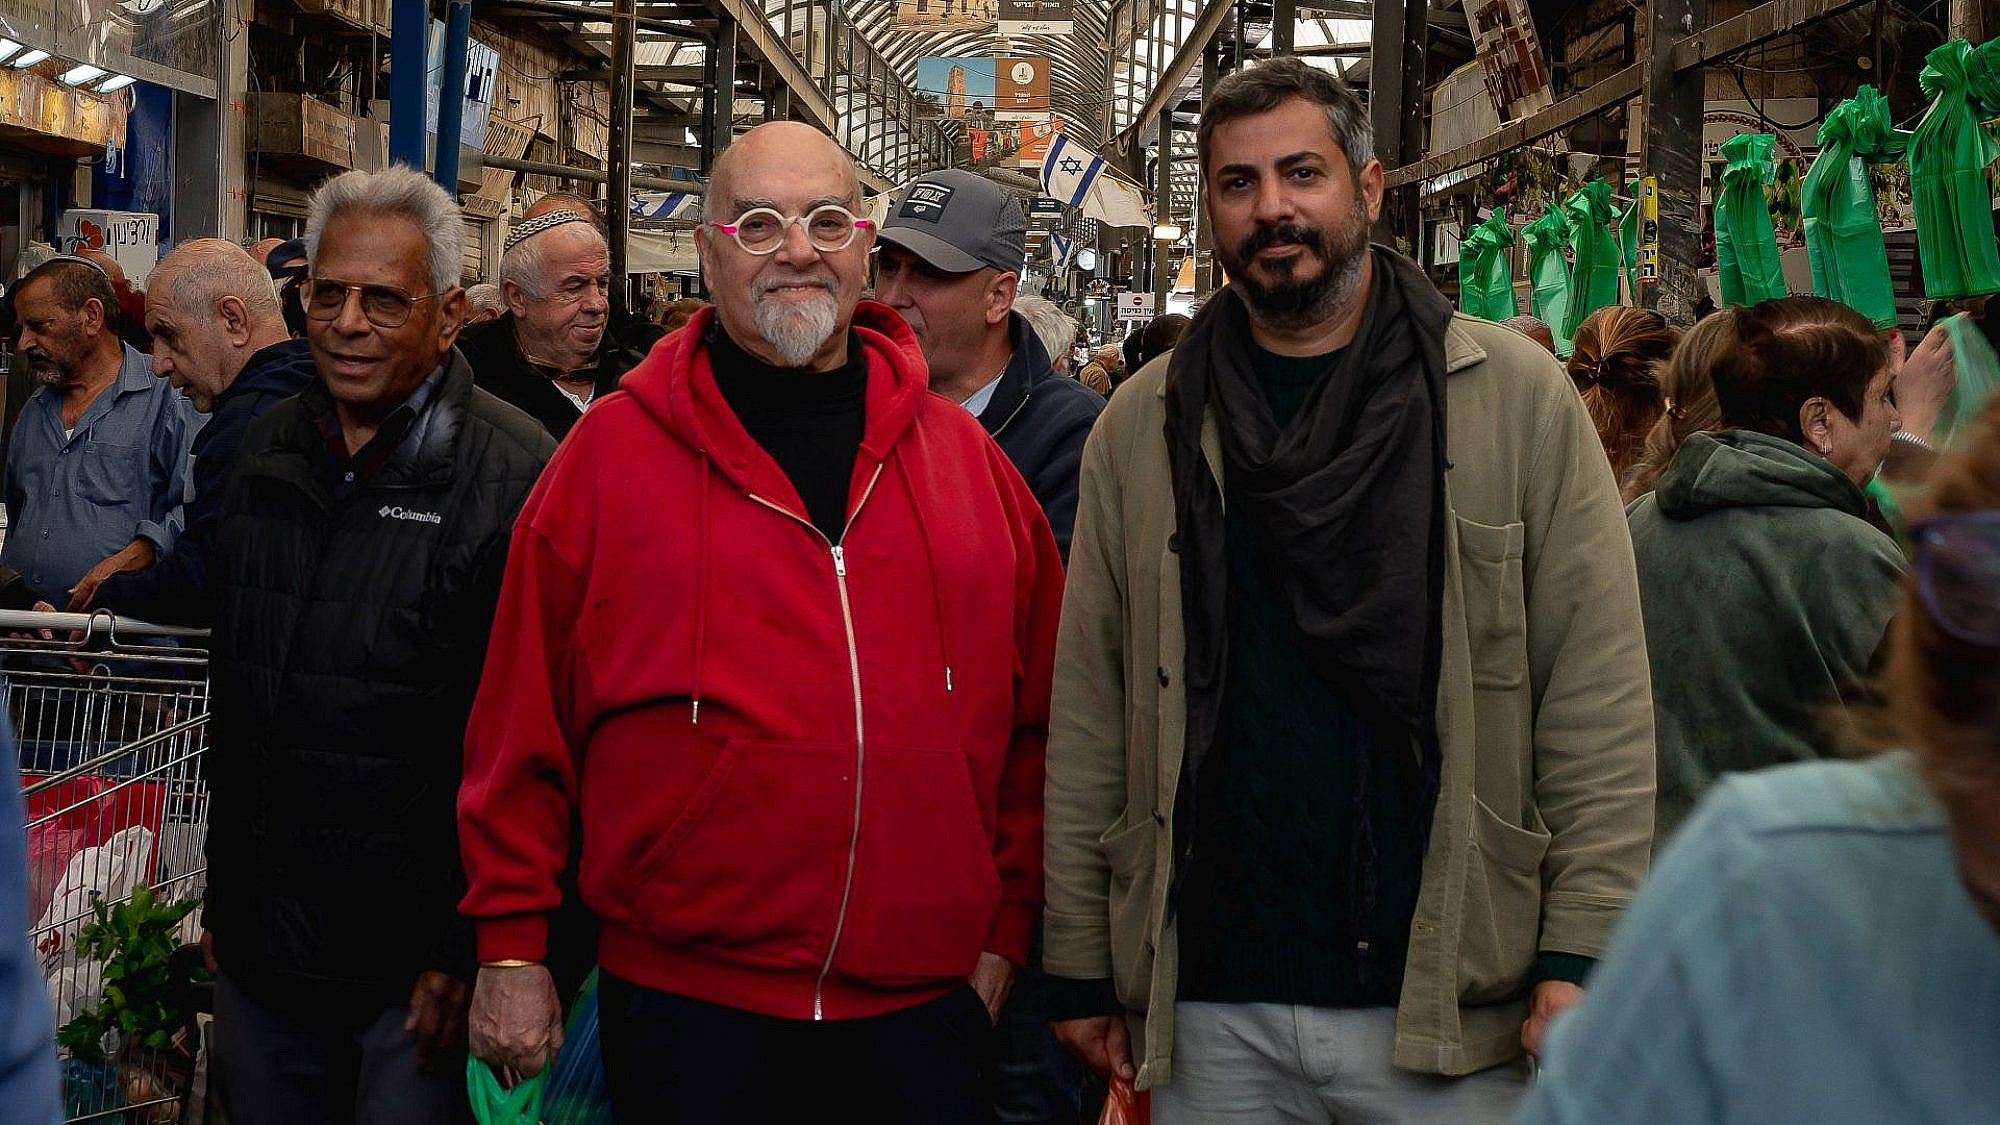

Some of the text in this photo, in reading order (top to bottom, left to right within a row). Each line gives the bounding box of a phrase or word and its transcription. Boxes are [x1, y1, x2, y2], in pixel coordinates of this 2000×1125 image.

[912, 188, 946, 202] FOX
[1121, 307, 1155, 315] אין כניסה
[391, 506, 442, 524] Columbia
